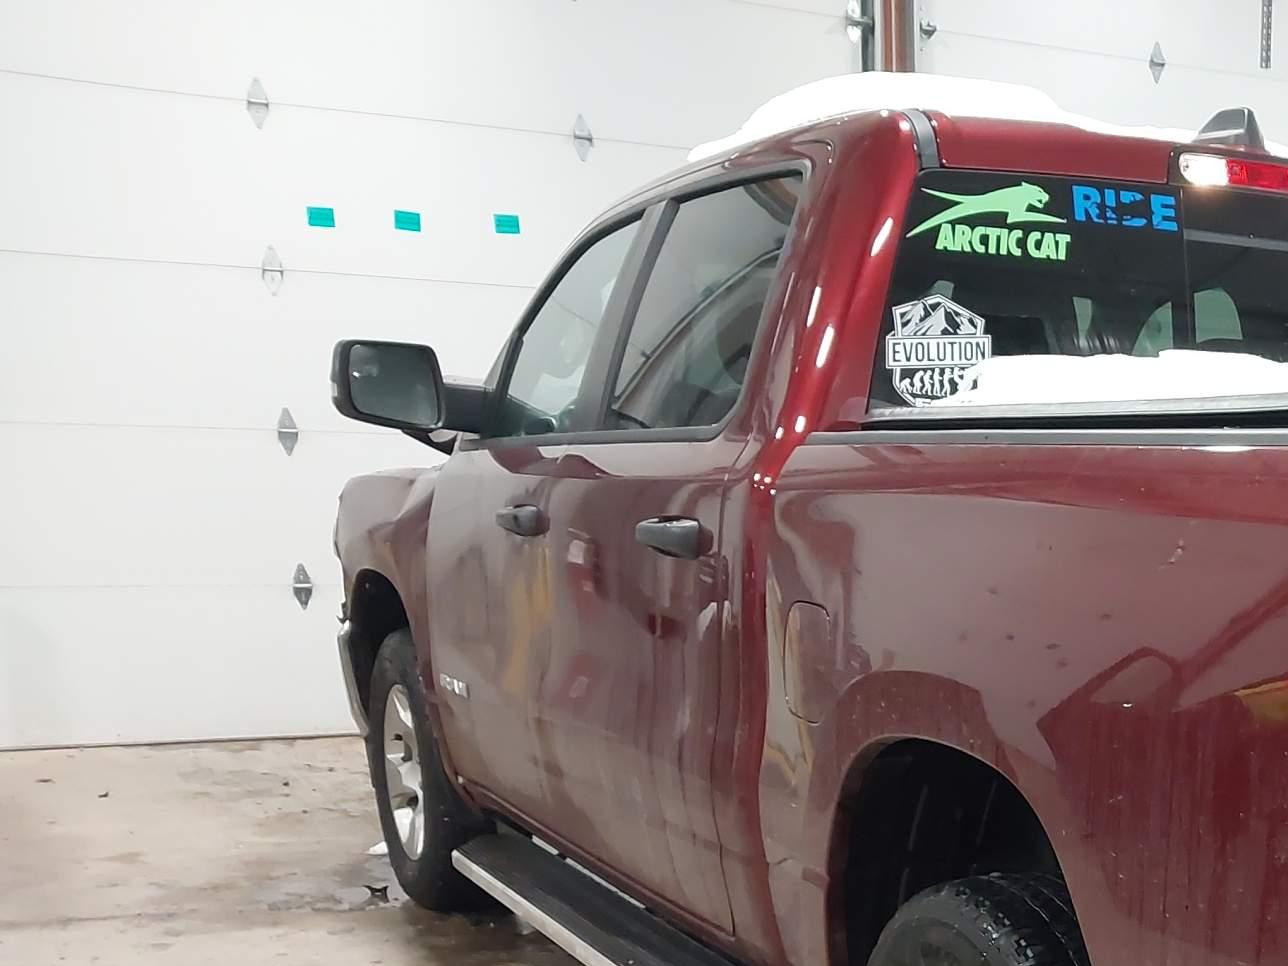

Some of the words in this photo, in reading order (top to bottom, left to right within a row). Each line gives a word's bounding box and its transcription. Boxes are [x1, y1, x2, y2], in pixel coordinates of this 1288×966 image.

[935, 223, 1023, 257] ARCTIC
[1027, 231, 1071, 260] CAT
[892, 341, 985, 362] EVOLUTION
